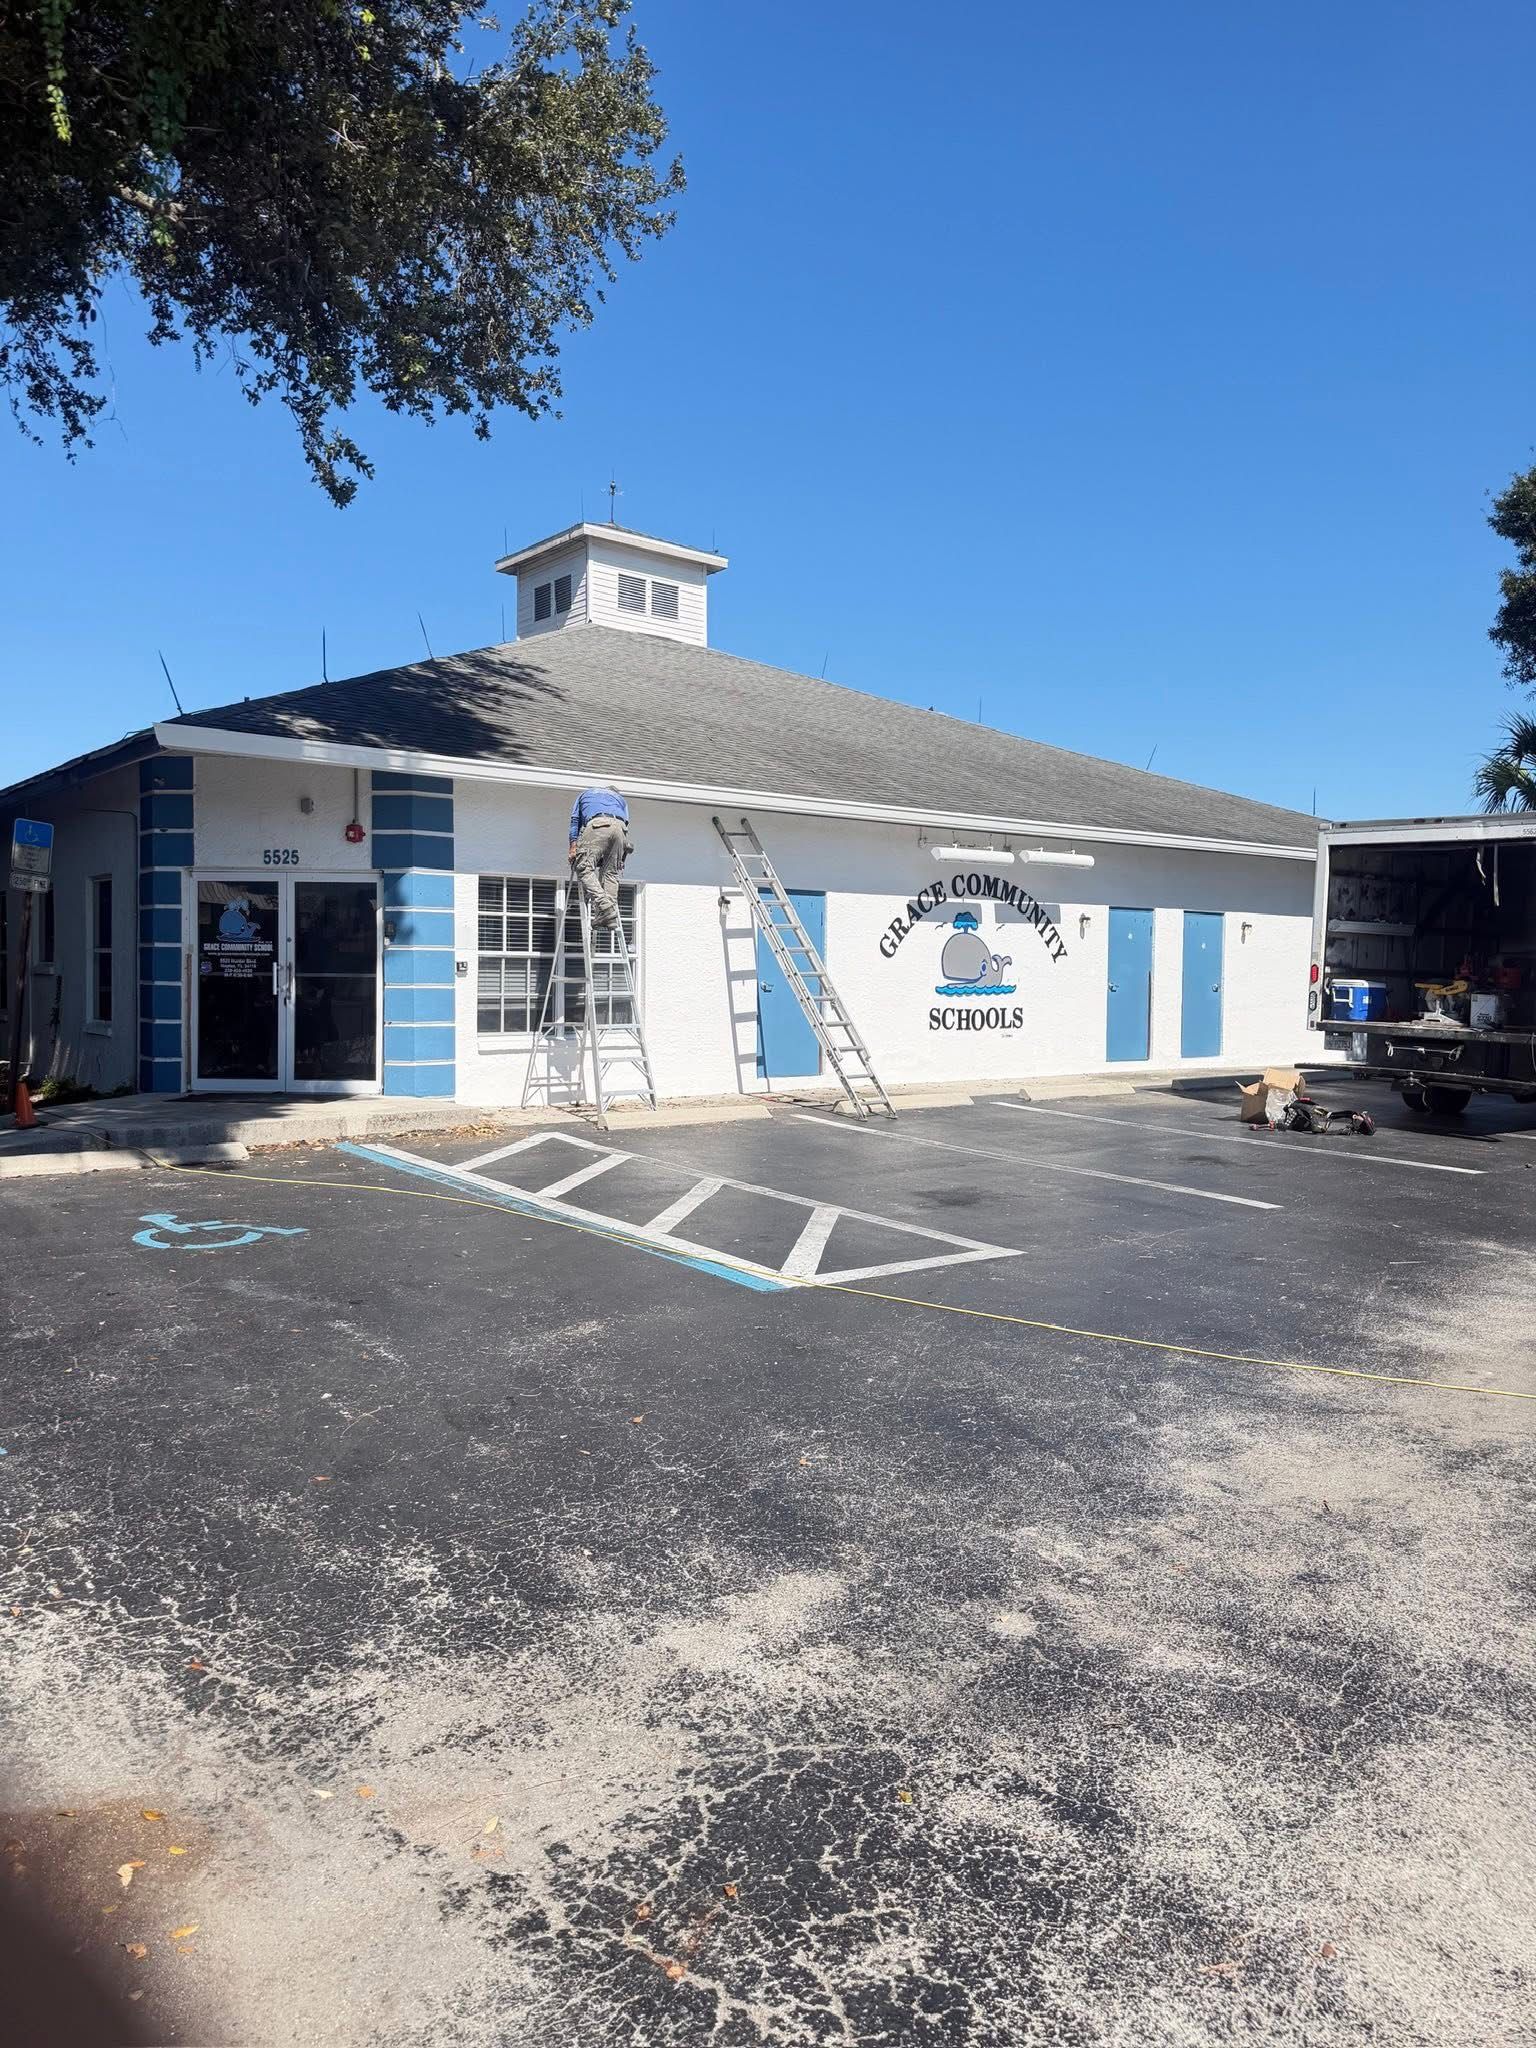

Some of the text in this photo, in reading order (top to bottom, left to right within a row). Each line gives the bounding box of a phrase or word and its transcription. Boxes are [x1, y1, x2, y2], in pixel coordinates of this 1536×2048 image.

[263, 849, 299, 865] 5525
[879, 873, 1068, 963] GRACE COMMUNITY
[203, 943, 273, 952] GRACE COMMUNITY SCHOOL
[929, 1007, 1023, 1030] SCHOOLS
